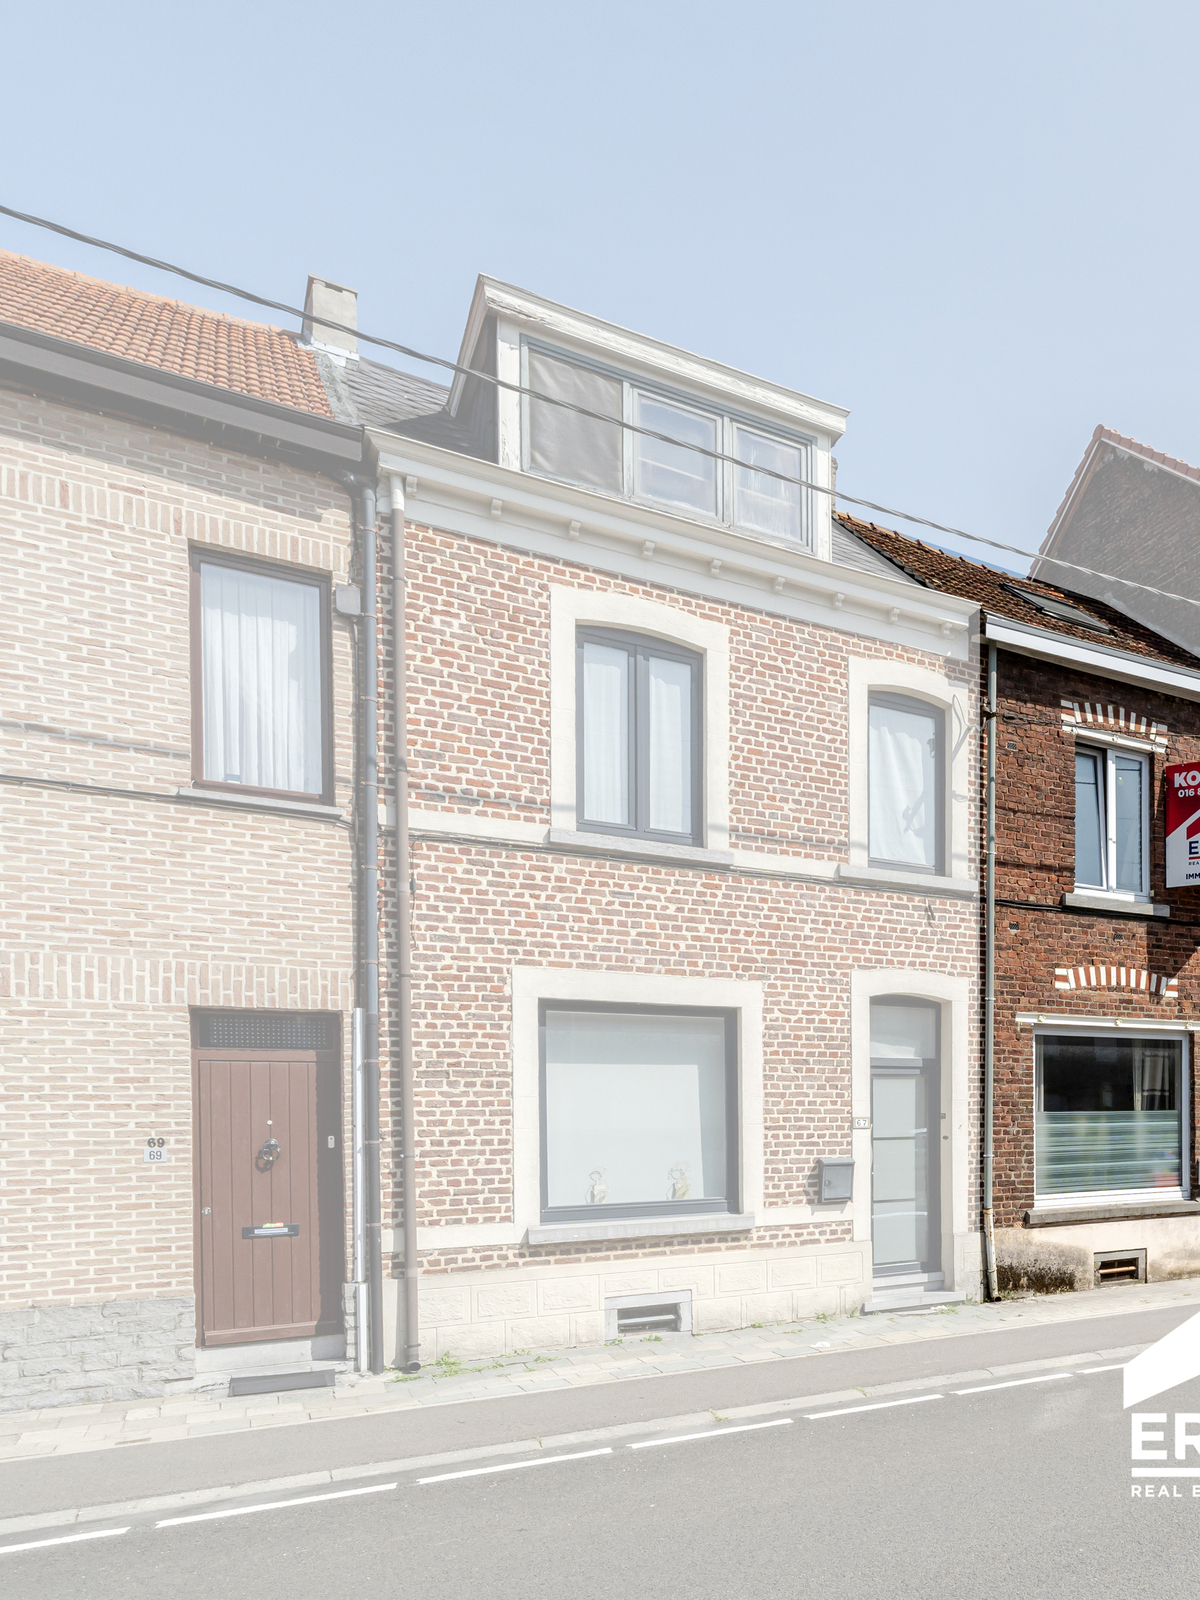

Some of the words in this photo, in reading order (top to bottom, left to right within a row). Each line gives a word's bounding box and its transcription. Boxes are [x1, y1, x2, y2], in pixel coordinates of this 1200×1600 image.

[1178, 788, 1195, 798] 016
[147, 1138, 166, 1148] 69
[149, 1150, 162, 1160] 69
